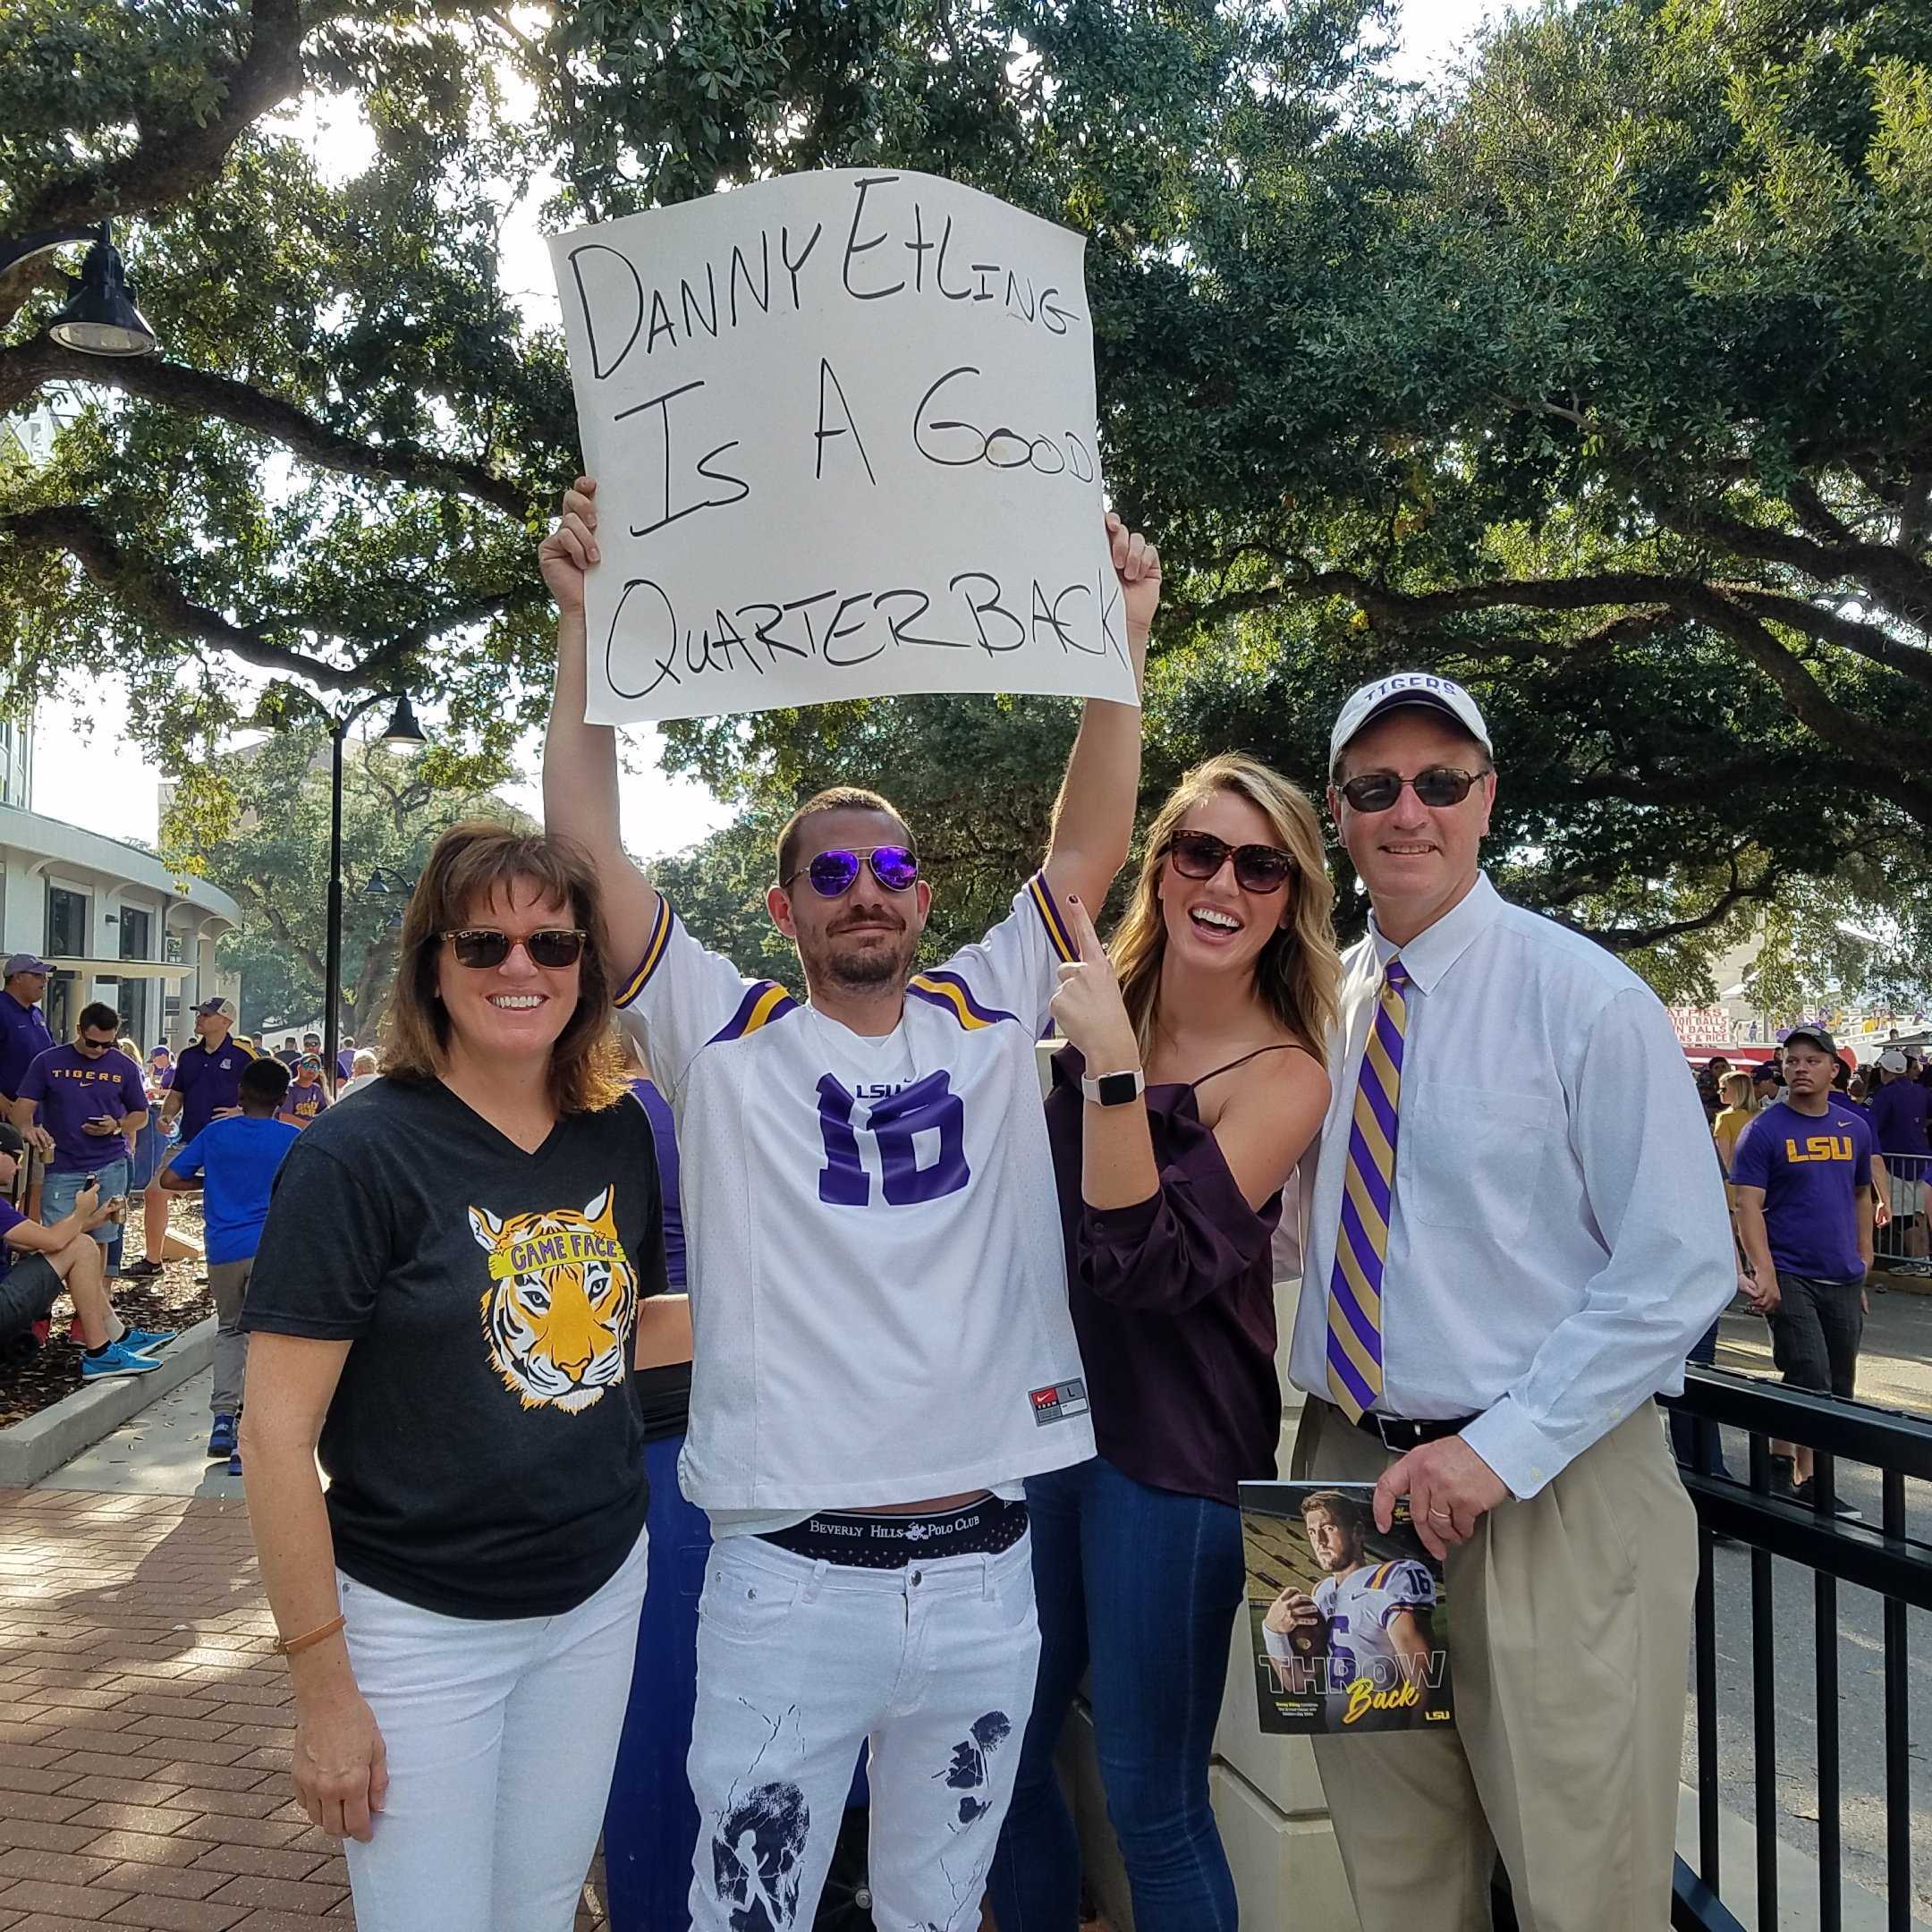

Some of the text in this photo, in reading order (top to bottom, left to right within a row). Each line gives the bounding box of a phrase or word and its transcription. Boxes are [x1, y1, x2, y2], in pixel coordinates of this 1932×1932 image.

[568, 224, 822, 380] DANNY
[813, 357, 877, 486] A
[912, 367, 1095, 484] GOOD
[1364, 676, 1457, 702] TIGERS
[52, 1069, 123, 1083] TIGERS
[856, 1084, 902, 1099] LSU
[1785, 1136, 1853, 1163] LSU
[511, 1234, 618, 1271] GAME FACE
[809, 1515, 980, 1538] BEVERLY HILLS POLO CLUB
[1405, 1568, 1430, 1596] 16
[1258, 1650, 1446, 1695] THROW
[1343, 1677, 1420, 1724] Back
[1425, 1710, 1451, 1721] LSU
